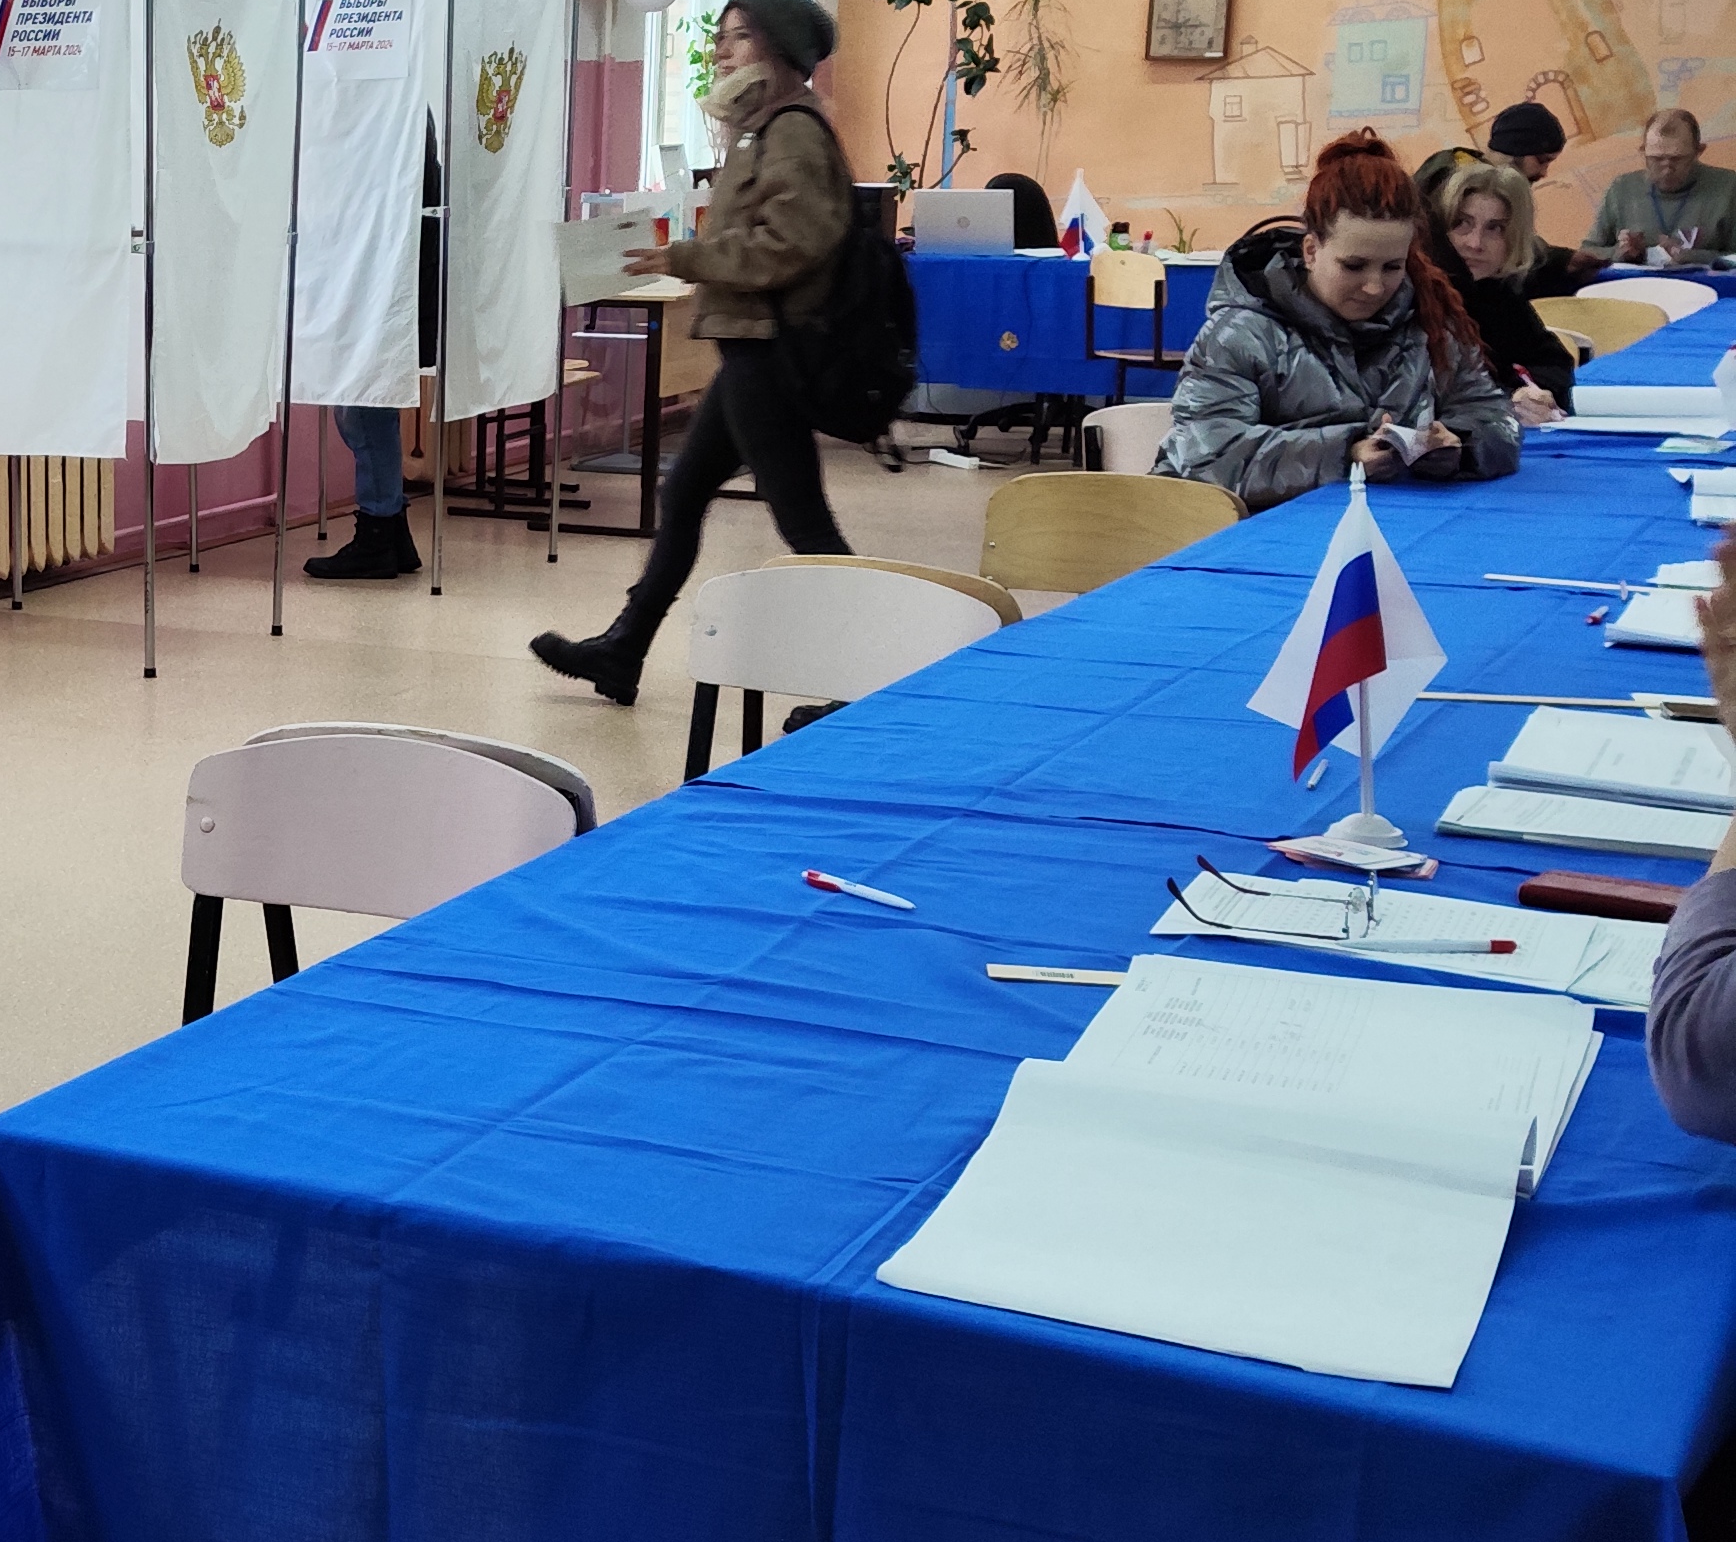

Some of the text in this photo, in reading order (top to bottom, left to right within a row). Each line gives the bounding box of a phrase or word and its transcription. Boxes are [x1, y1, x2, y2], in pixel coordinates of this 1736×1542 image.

[16, 11, 93, 26] ПРЕЗИДЕНТА
[334, 10, 403, 24] ПРЕЗИДЕНТА
[11, 29, 61, 42] РОССИИ
[329, 26, 374, 39] РОССИИ
[31, 45, 62, 57] МАРТА
[63, 44, 82, 56] 2024
[347, 40, 374, 51] МАРТА
